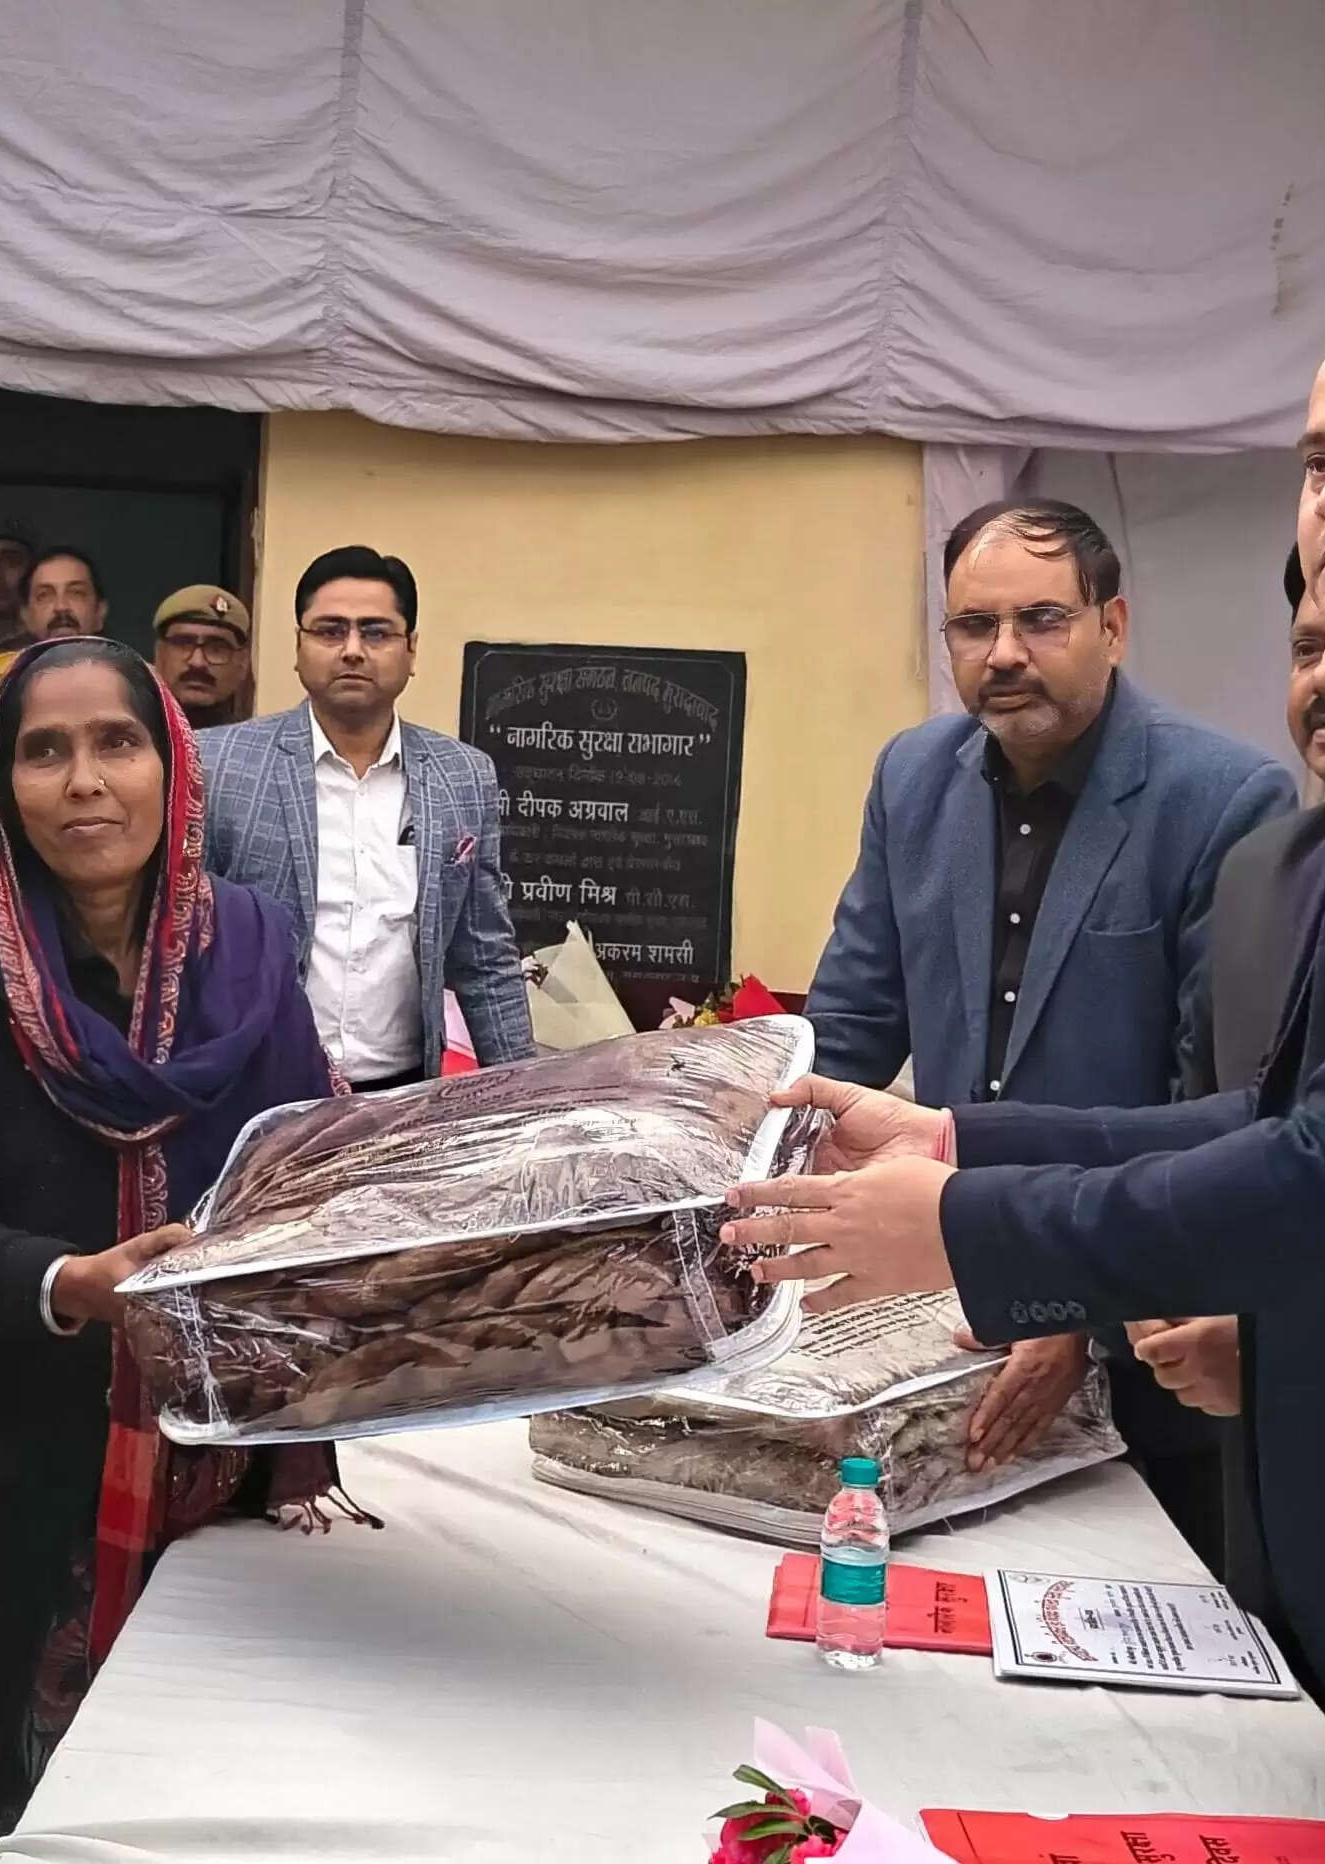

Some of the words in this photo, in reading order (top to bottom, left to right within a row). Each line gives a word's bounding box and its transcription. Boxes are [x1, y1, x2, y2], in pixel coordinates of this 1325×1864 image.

[578, 732, 624, 760] सुरक्षा
[517, 790, 563, 819] दीपक
[568, 799, 629, 822] अग्रवाल
[521, 874, 571, 902] प्रवीण
[579, 877, 617, 905] मिश्र
[595, 942, 641, 962] अकरम
[1120, 1831, 1175, 1864] सुरक्षा
